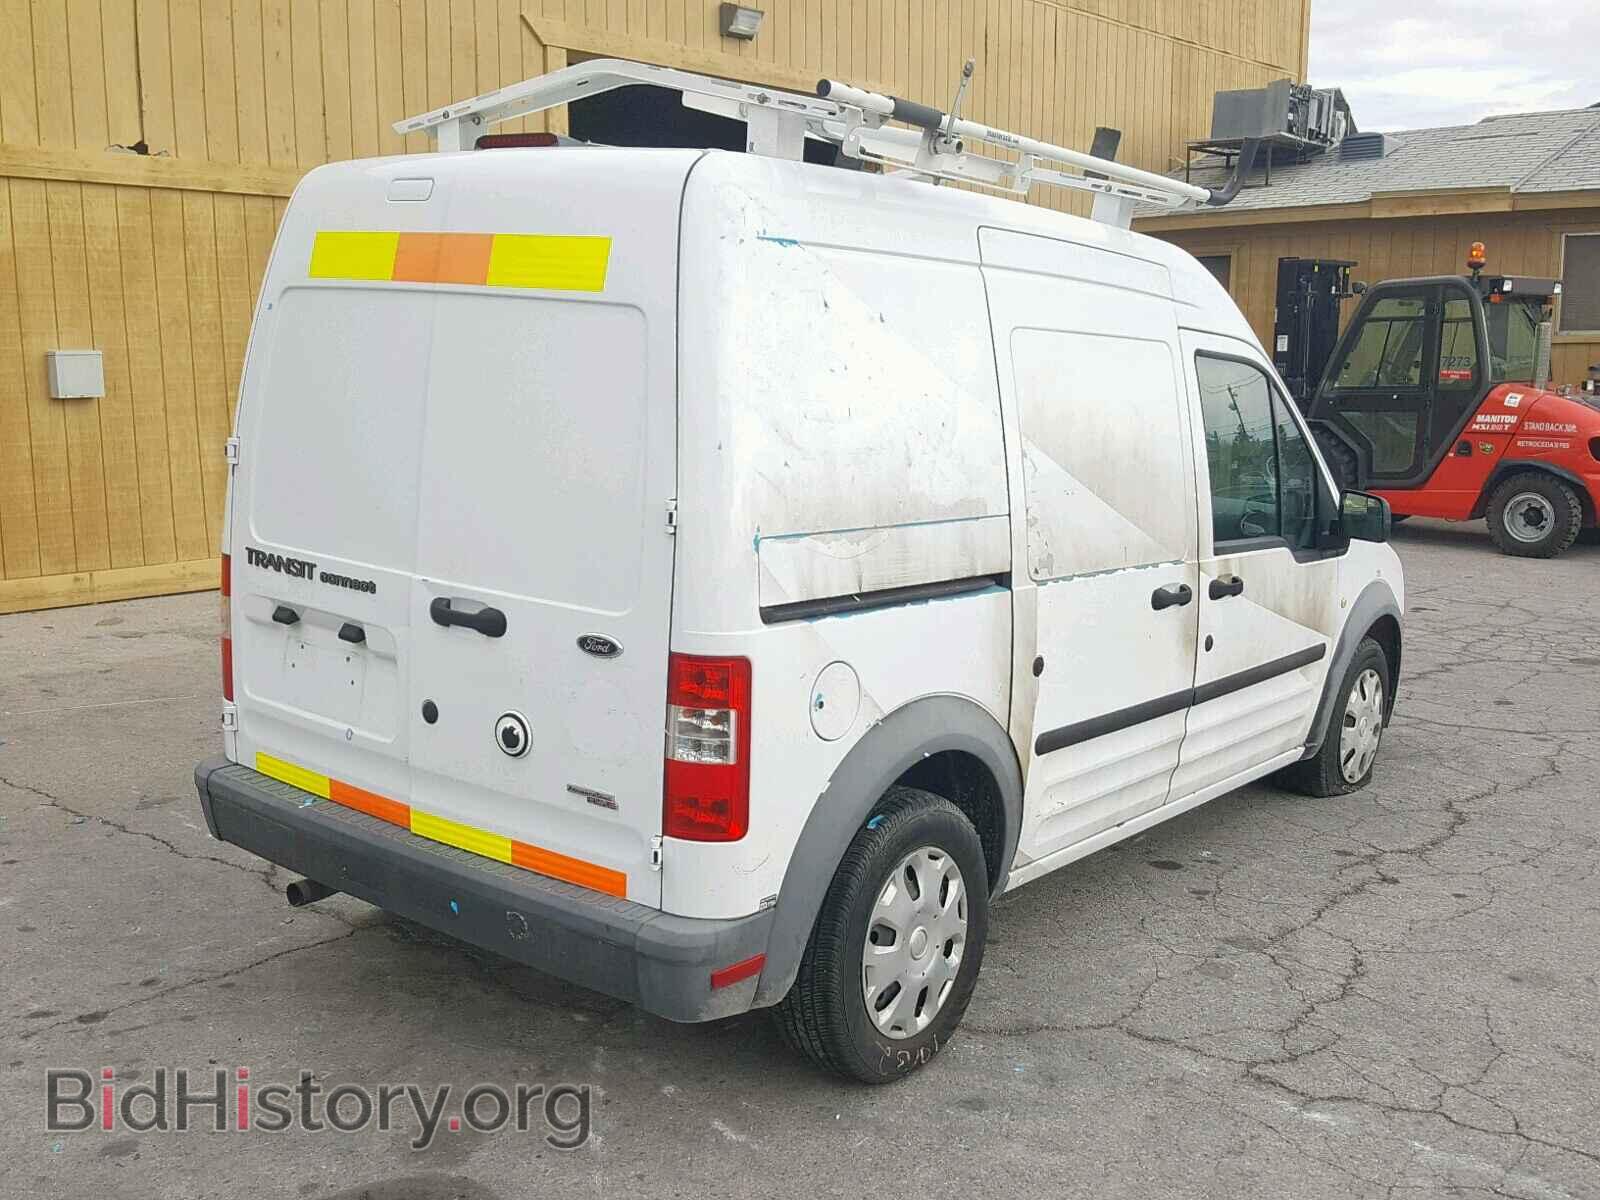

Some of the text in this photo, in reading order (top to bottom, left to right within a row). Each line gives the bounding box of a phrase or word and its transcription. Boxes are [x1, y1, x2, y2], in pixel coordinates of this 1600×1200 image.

[1440, 356, 1472, 368] 7273
[1476, 414, 1518, 424] MANITOU
[1524, 421, 1544, 431] STAND
[1545, 422, 1564, 432] BACK
[245, 546, 376, 594] TRANSIT connect
[583, 638, 611, 653] Ford
